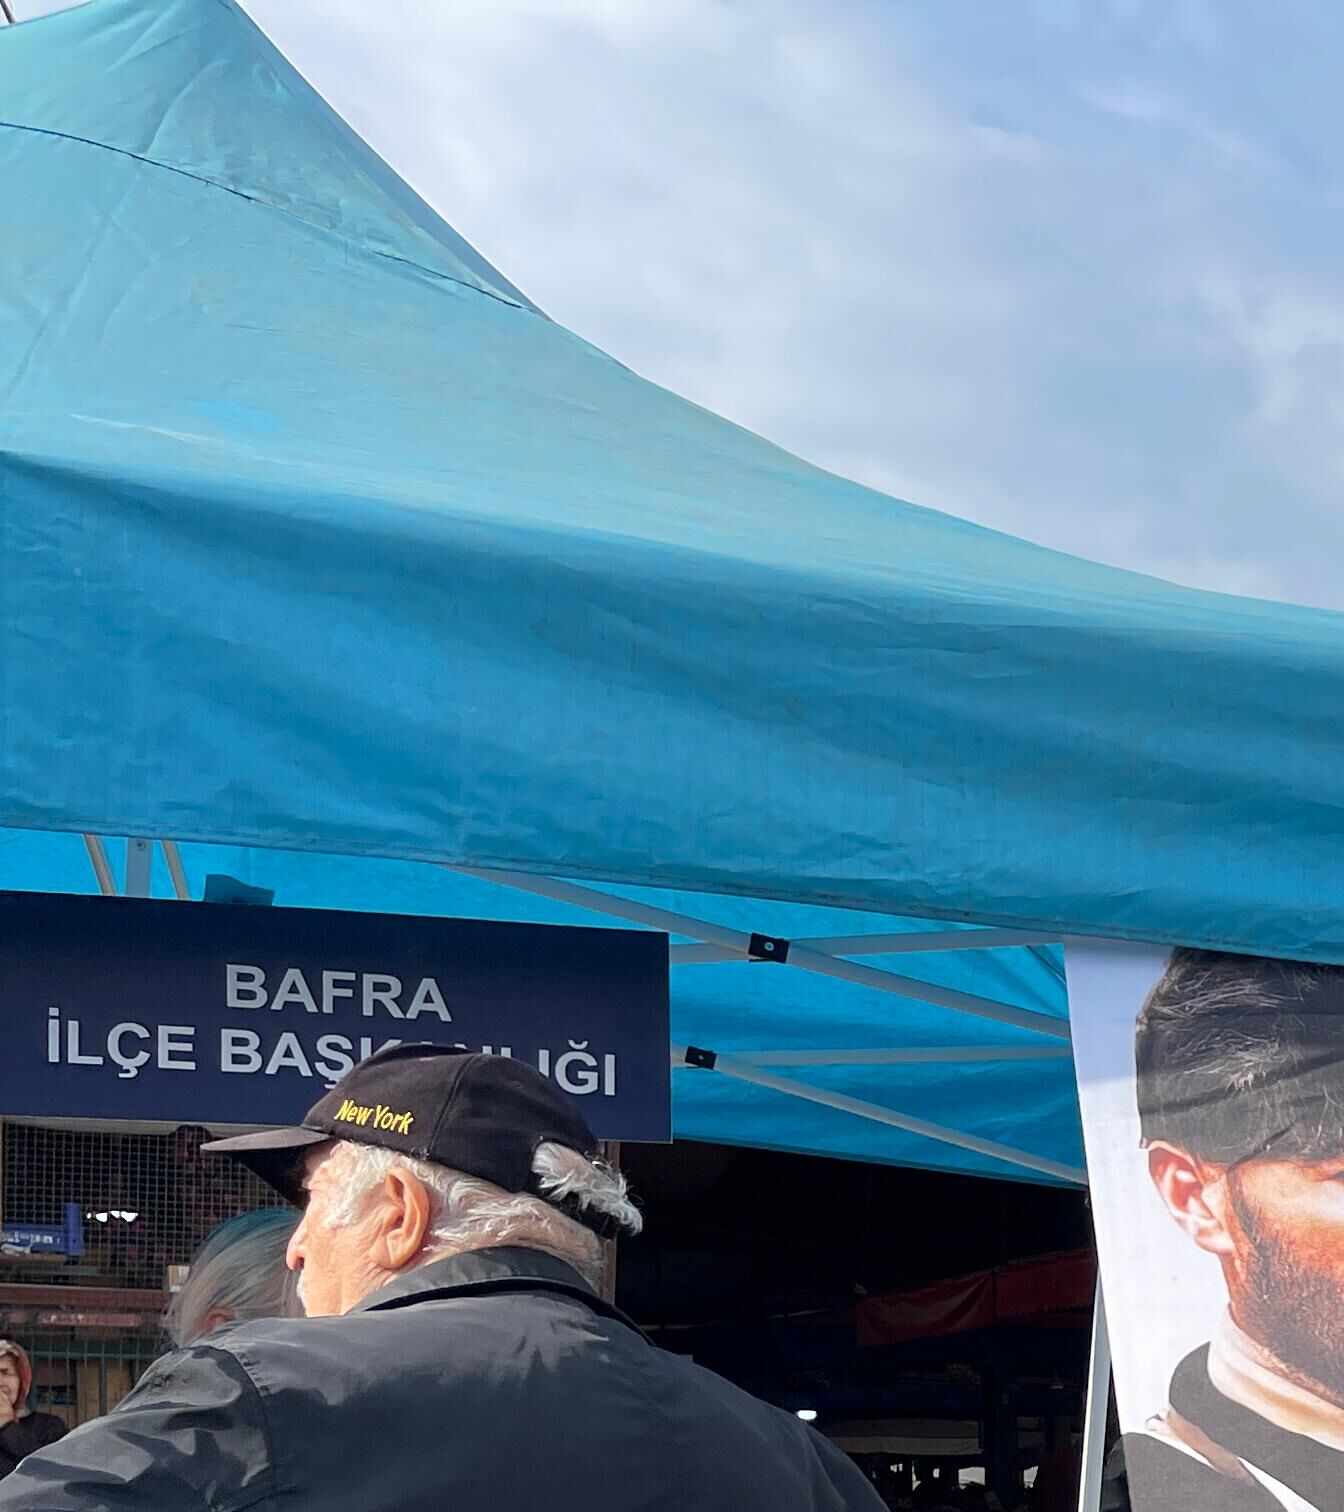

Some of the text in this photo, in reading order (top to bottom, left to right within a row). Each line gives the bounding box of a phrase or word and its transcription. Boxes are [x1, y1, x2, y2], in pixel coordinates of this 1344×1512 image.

[225, 962, 453, 1023] BAFRA
[46, 1006, 617, 1097] İLÇE BAŞIĞI
[333, 1099, 414, 1136] New York
